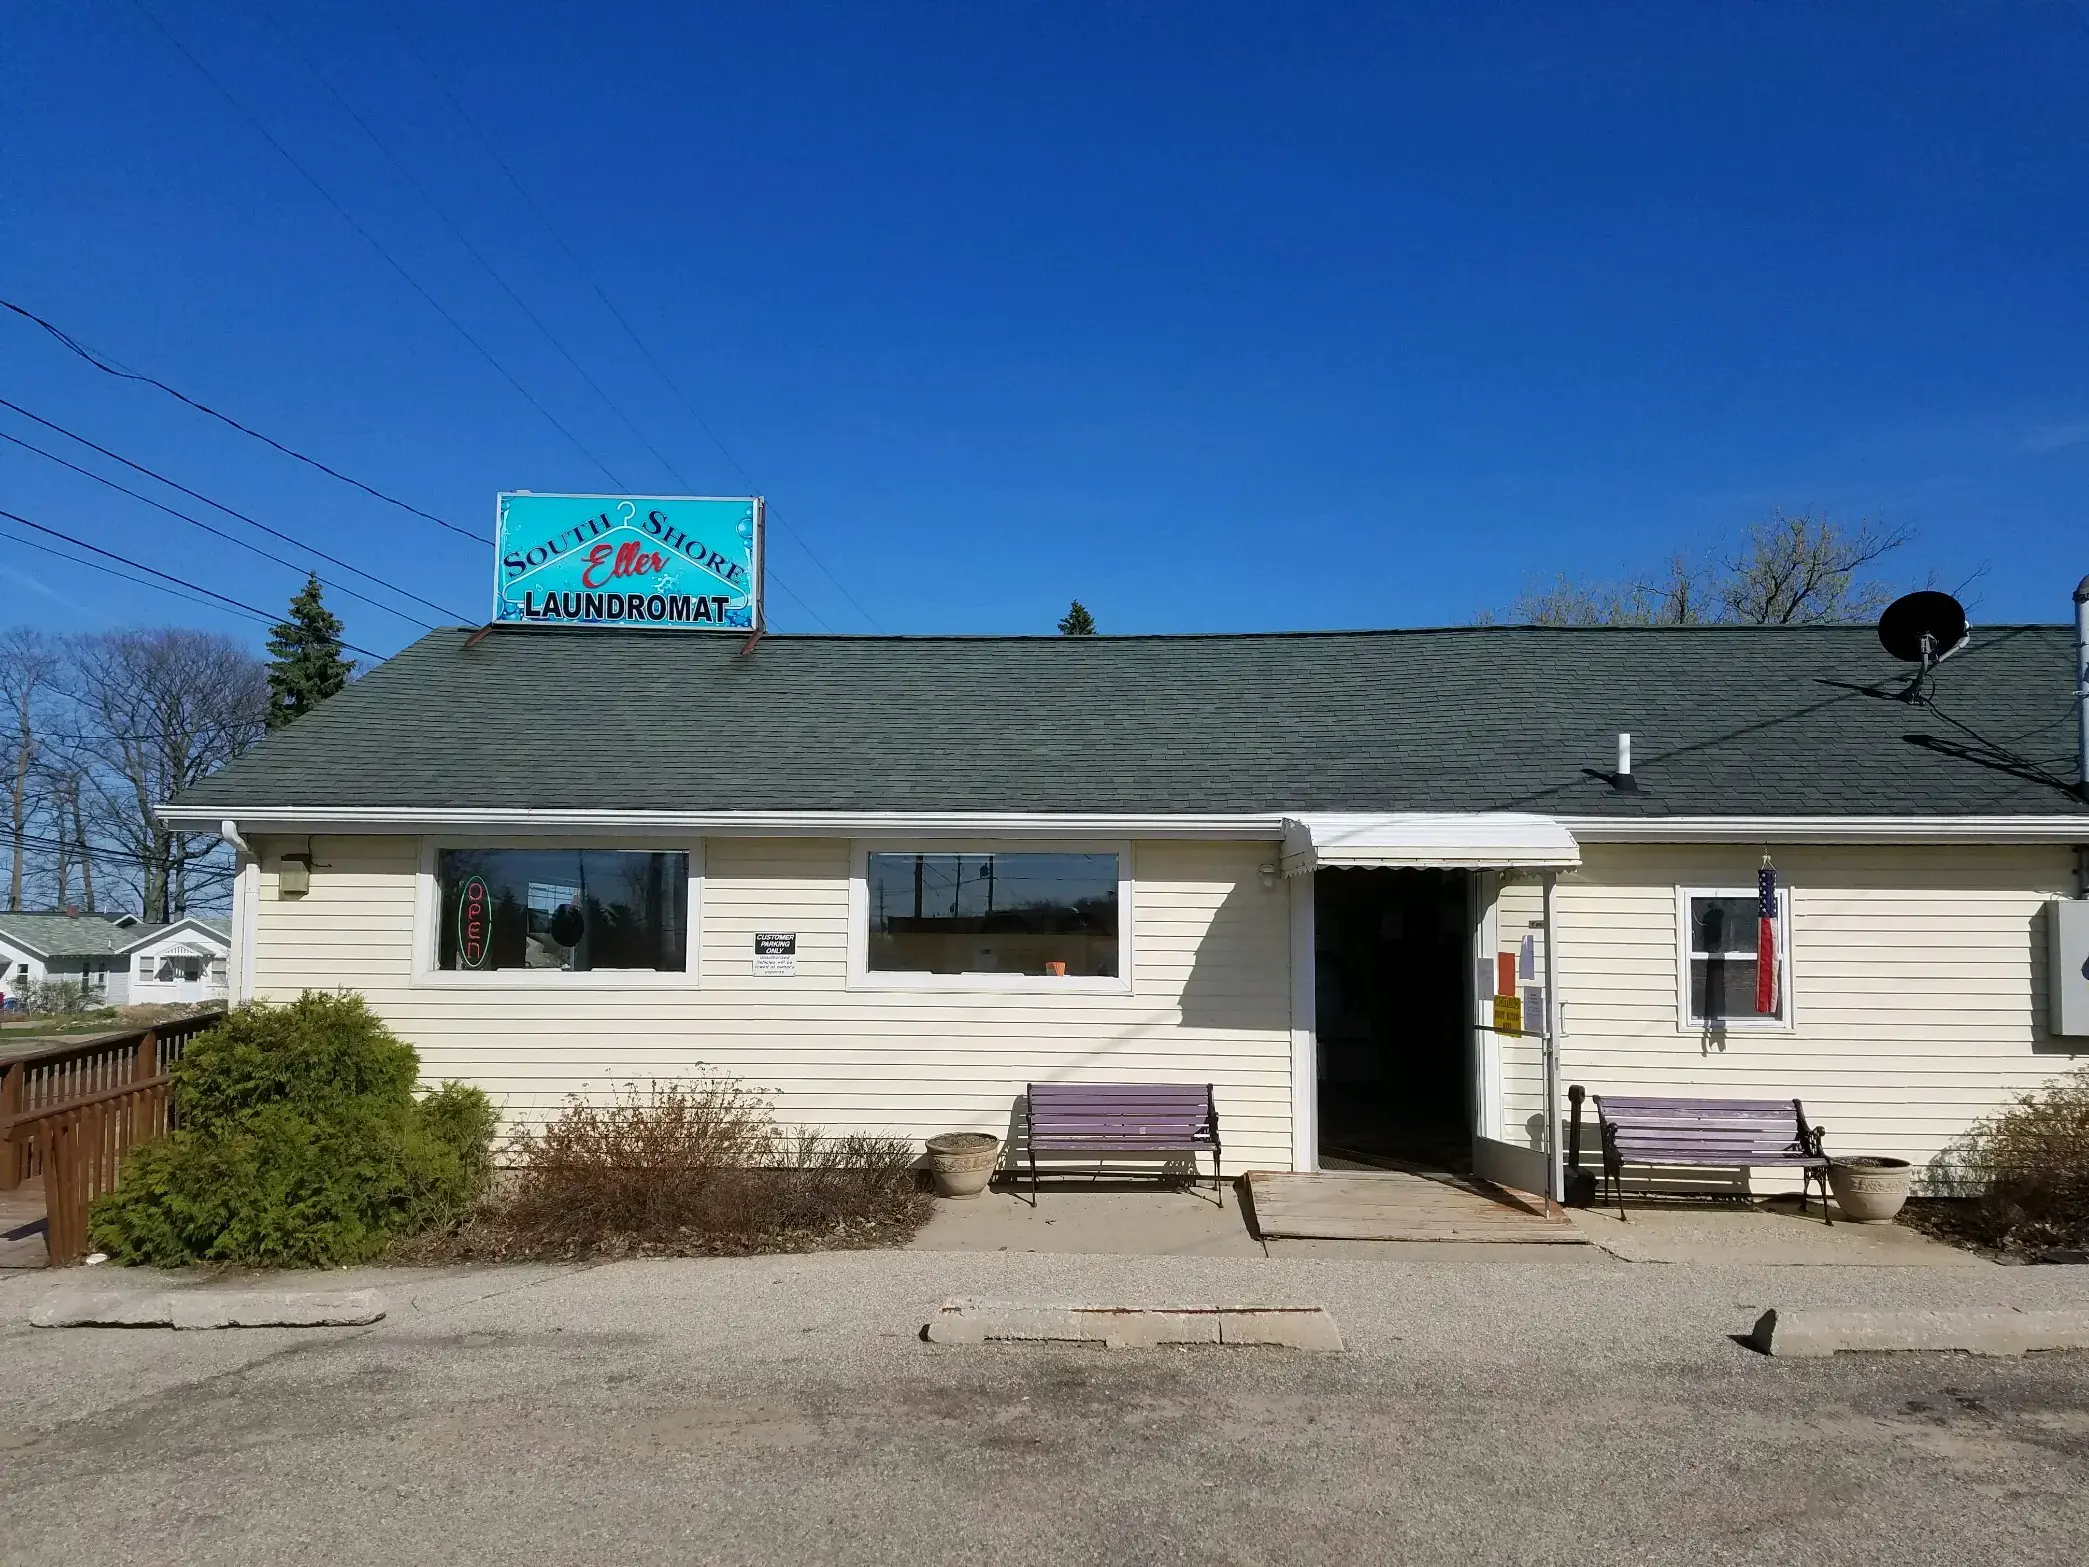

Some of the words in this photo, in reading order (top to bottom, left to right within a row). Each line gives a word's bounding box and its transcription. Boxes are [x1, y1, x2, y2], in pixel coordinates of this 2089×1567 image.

[503, 513, 613, 578] SOUTH
[642, 510, 745, 584] SHORE
[581, 541, 670, 589] Eller
[524, 591, 730, 623] LAUNDROMAT
